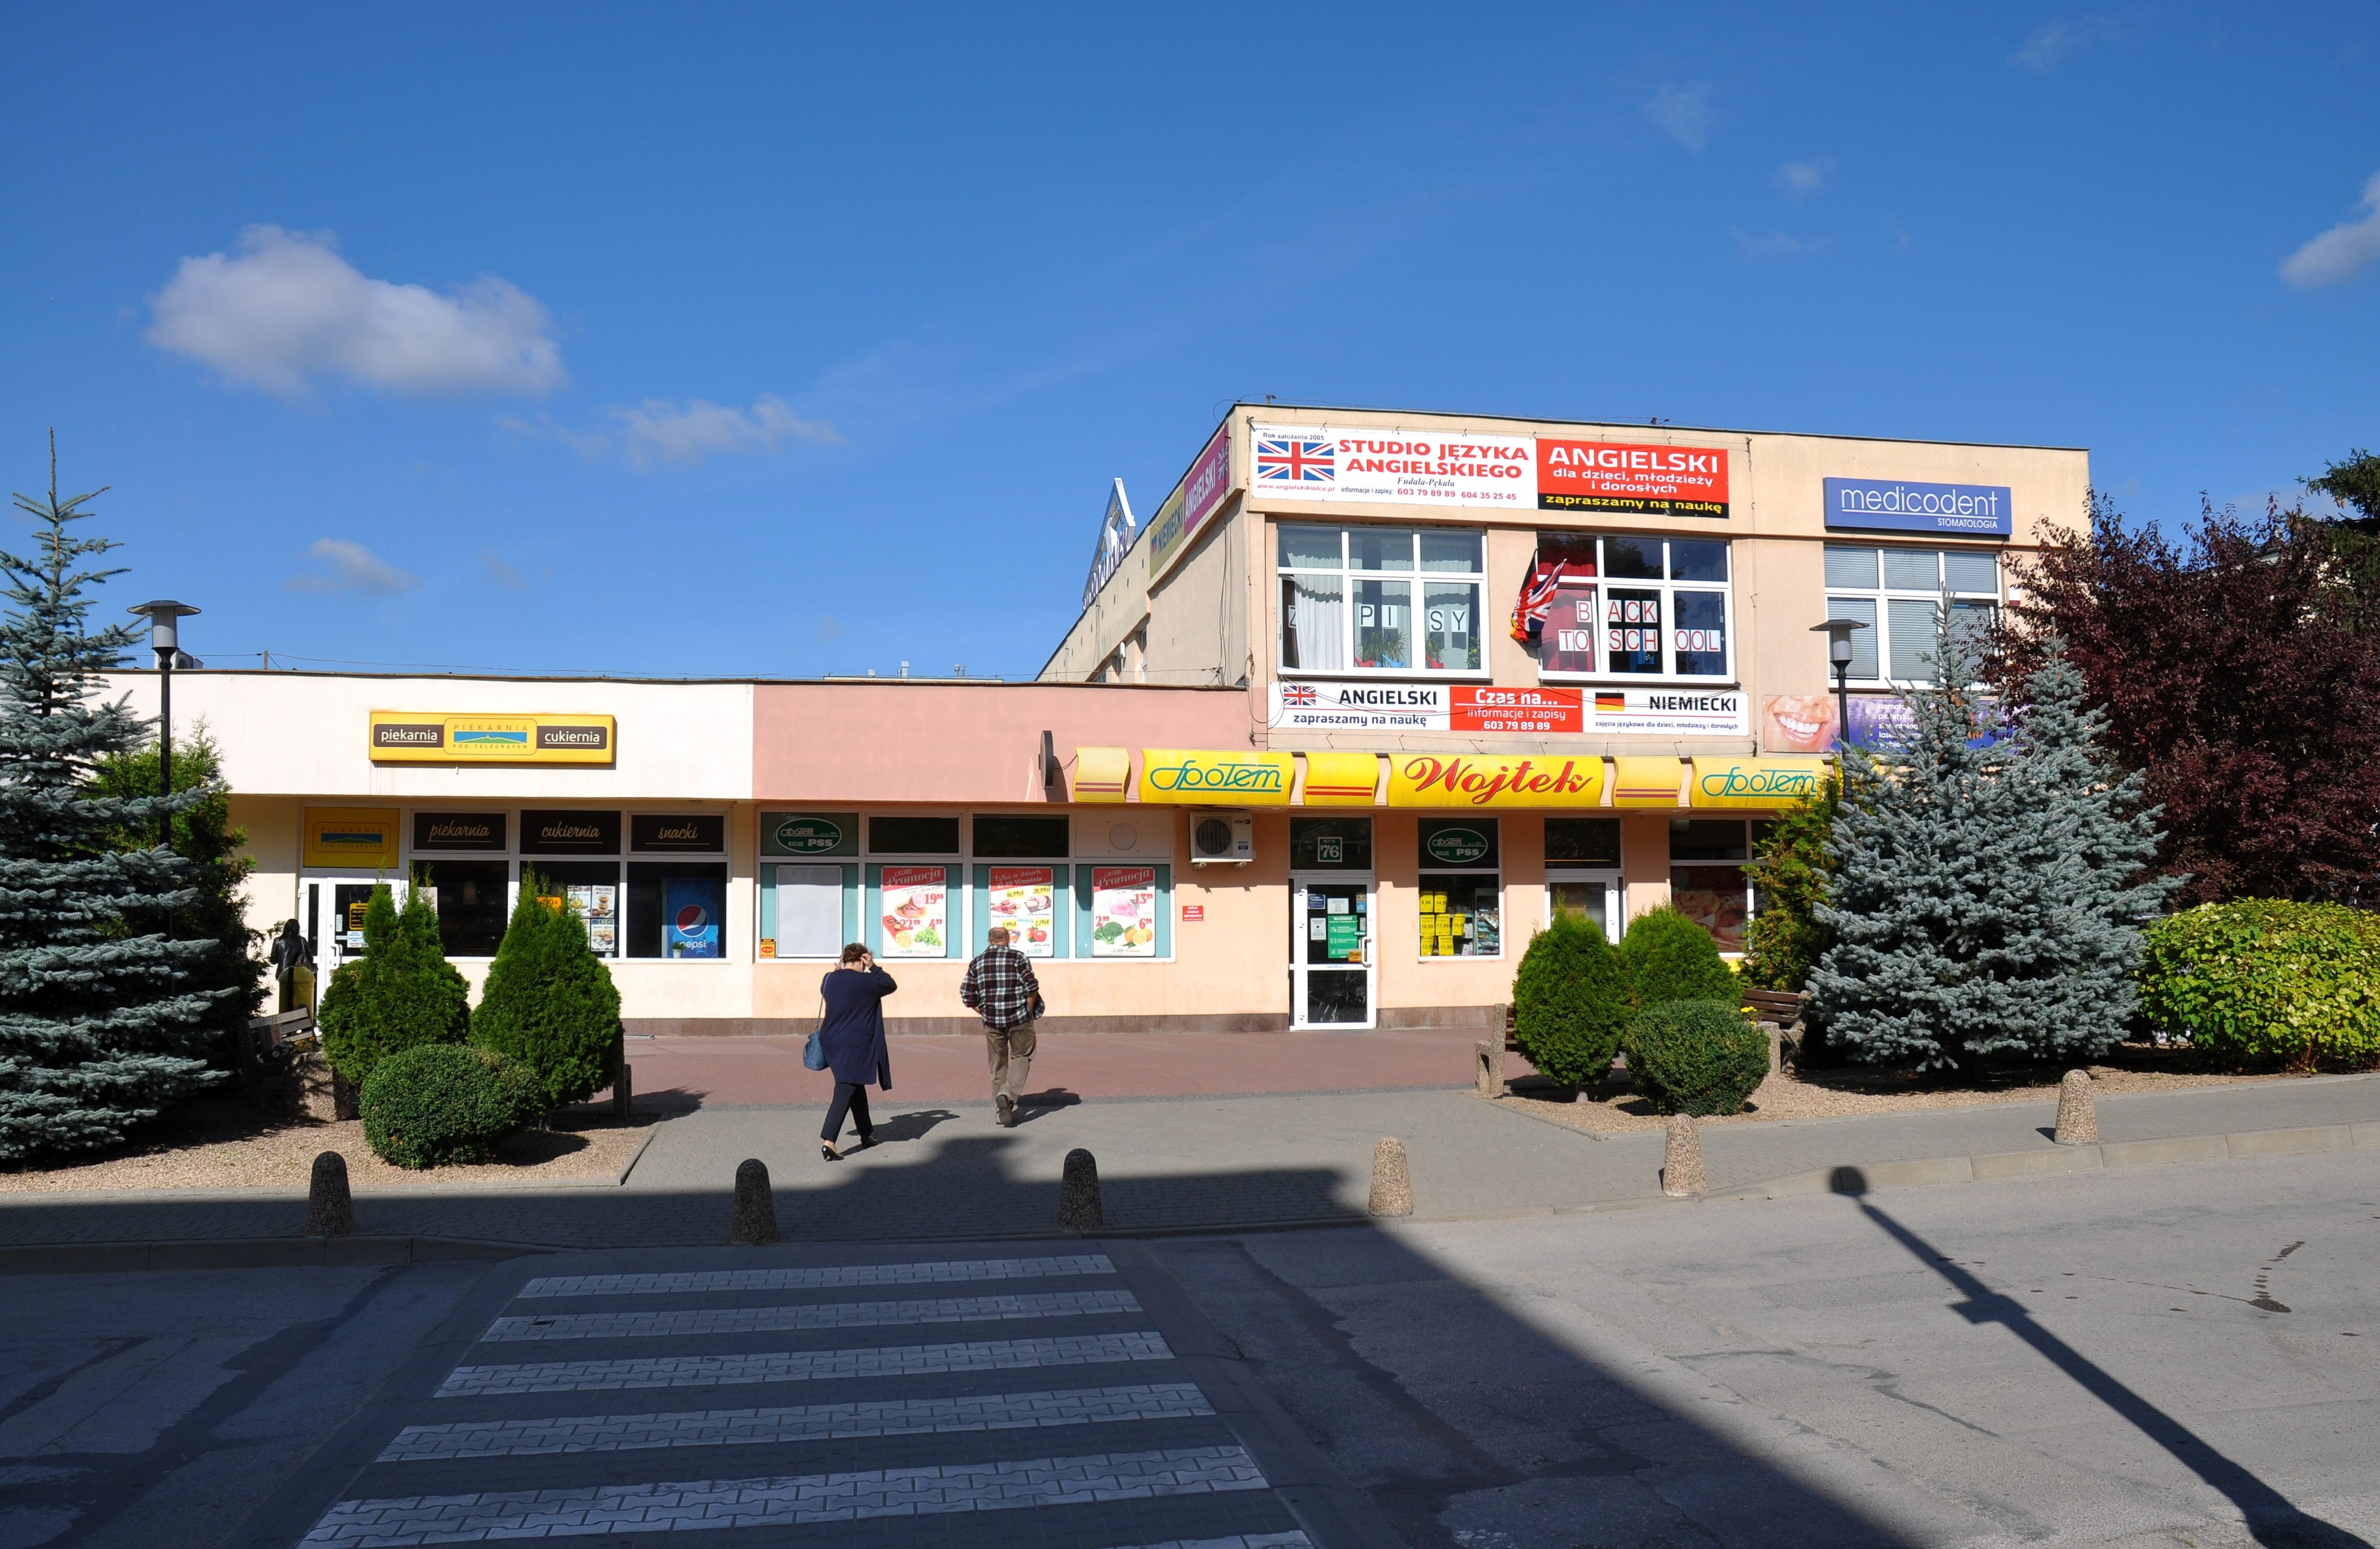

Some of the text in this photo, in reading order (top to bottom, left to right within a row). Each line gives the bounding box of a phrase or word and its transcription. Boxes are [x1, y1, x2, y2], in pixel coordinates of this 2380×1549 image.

[1339, 439, 1529, 461] STUDIO JĘZYKA
[1346, 459, 1522, 478] ANGIELSKIEGO
[1549, 447, 1717, 473] ANGIELSKI
[1553, 468, 1713, 487] dla dzieci, młodzieży
[1184, 458, 1216, 522] ANGIELSKI
[1257, 483, 1335, 493] www.angielskikielce.pl
[1591, 481, 1677, 495] i dorosłych
[1546, 495, 1722, 514] zapraszamy na naukę
[1841, 486, 1998, 516] medicodent
[1158, 501, 1183, 554] NIEMIECKI
[1938, 517, 1998, 529] STOMATOLOGIA
[1578, 601, 1657, 622] BACK
[1560, 630, 1719, 650] TO SCHOOL
[1339, 689, 1437, 705] ANGIELSKI
[1475, 688, 1558, 705] Czas na...
[1650, 696, 1737, 711] NIEMIECKI
[1294, 714, 1427, 727] zapraszamy na naukę
[1468, 707, 1566, 721] informacje i zapisy
[381, 729, 437, 741] piekarnia
[1484, 721, 1550, 731] 603 79 89 89
[544, 731, 600, 742] cukiernia
[1404, 758, 1593, 804] Wojtek
[428, 820, 490, 841] piekarnia
[541, 821, 600, 838] cukiernia
[657, 822, 699, 840] snacki
[1321, 844, 1340, 858] 76
[887, 868, 941, 887] Promocja
[1014, 876, 1043, 885] Września
[1097, 869, 1150, 888] Promocja
